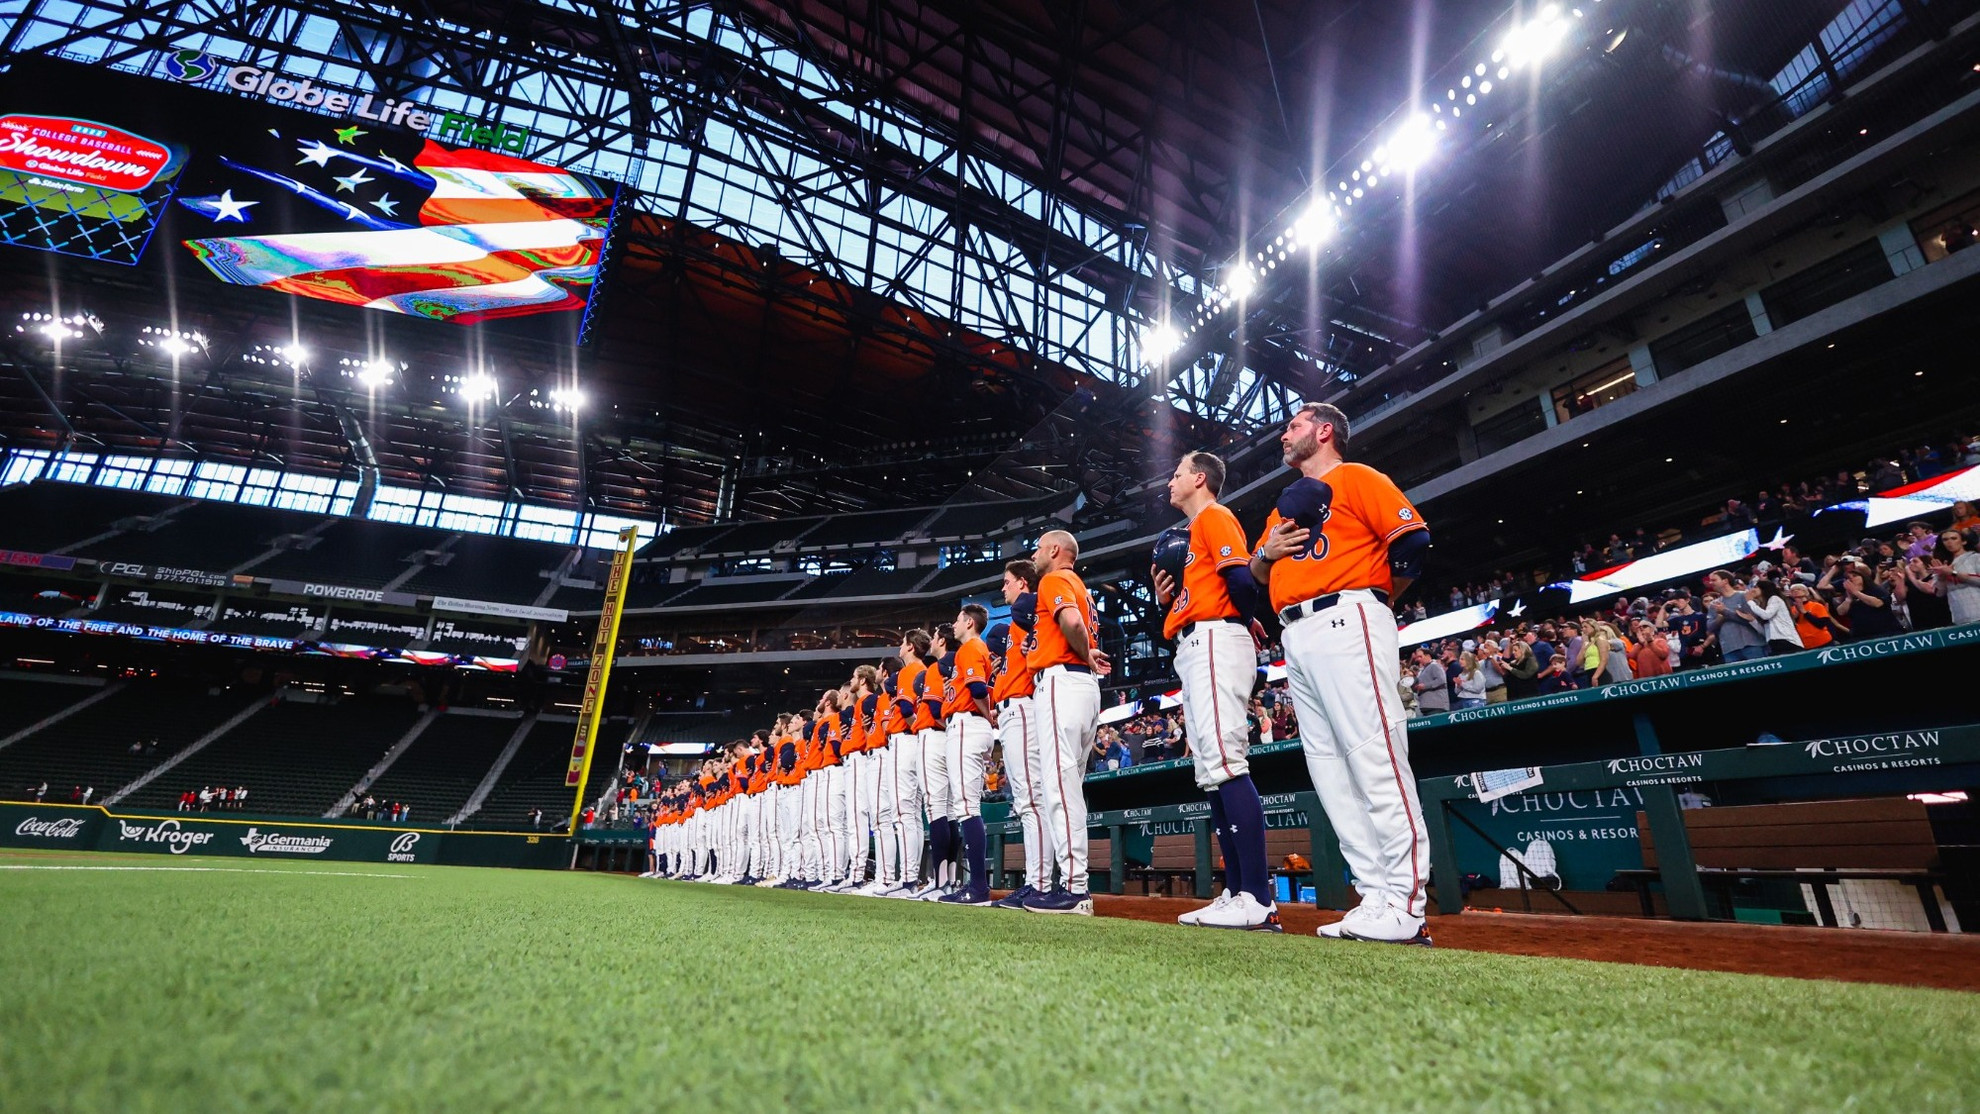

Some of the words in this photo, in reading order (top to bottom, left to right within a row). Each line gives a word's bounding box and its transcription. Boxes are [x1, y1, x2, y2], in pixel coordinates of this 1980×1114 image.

[226, 65, 350, 113] Globe
[357, 93, 430, 131] Life
[439, 113, 529, 152] Field
[32, 128, 78, 143] COLLEGE
[80, 138, 132, 155] BASEBALL
[0, 132, 150, 177] Showdown
[66, 167, 85, 178] Life
[111, 562, 147, 576] PGL
[611, 552, 625, 592] THE
[303, 583, 385, 602] POWERADE
[0, 614, 32, 626] LAND
[36, 618, 54, 627] OF
[58, 620, 82, 630] THE
[84, 622, 114, 633] FREE
[116, 625, 144, 636] AND
[147, 628, 170, 638] THE
[172, 631, 207, 642] HOME
[210, 634, 227, 643] OF
[230, 635, 253, 646] THE
[254, 638, 294, 649] BRAVE
[600, 602, 614, 642] HOT
[1827, 634, 1935, 663] CHOCTAW
[1948, 629, 1980, 641] CASI
[585, 654, 602, 712] ZONE
[1609, 676, 1681, 698] CHOCTAW
[1689, 671, 1729, 683] CASINOS
[1731, 668, 1738, 676] &
[1739, 661, 1783, 675] RESORTS
[1453, 706, 1507, 724] CHOCTAW
[1512, 703, 1541, 712] CASINOS
[1548, 695, 1578, 706] RESORTS
[1408, 720, 1431, 729] RESORTS
[1249, 743, 1280, 756] CHOCTAW
[1817, 731, 1939, 757] CHOCTAW
[1614, 754, 1703, 774] CHOCTAW
[1833, 762, 1879, 773] CASINOS
[1881, 761, 1889, 769] &
[1892, 757, 1941, 768] RESORTS
[1626, 779, 1659, 787] CASINOS
[1667, 774, 1702, 785] RESORTS
[1146, 821, 1196, 837] CHOCTA
[1264, 812, 1309, 827] CTAW
[145, 820, 214, 854] Kroger
[267, 833, 331, 848] Germania
[1517, 829, 1575, 843] CASINOS
[1579, 829, 1587, 840] &
[1591, 827, 1639, 840] RESOR
[388, 853, 416, 862] SPORTS
